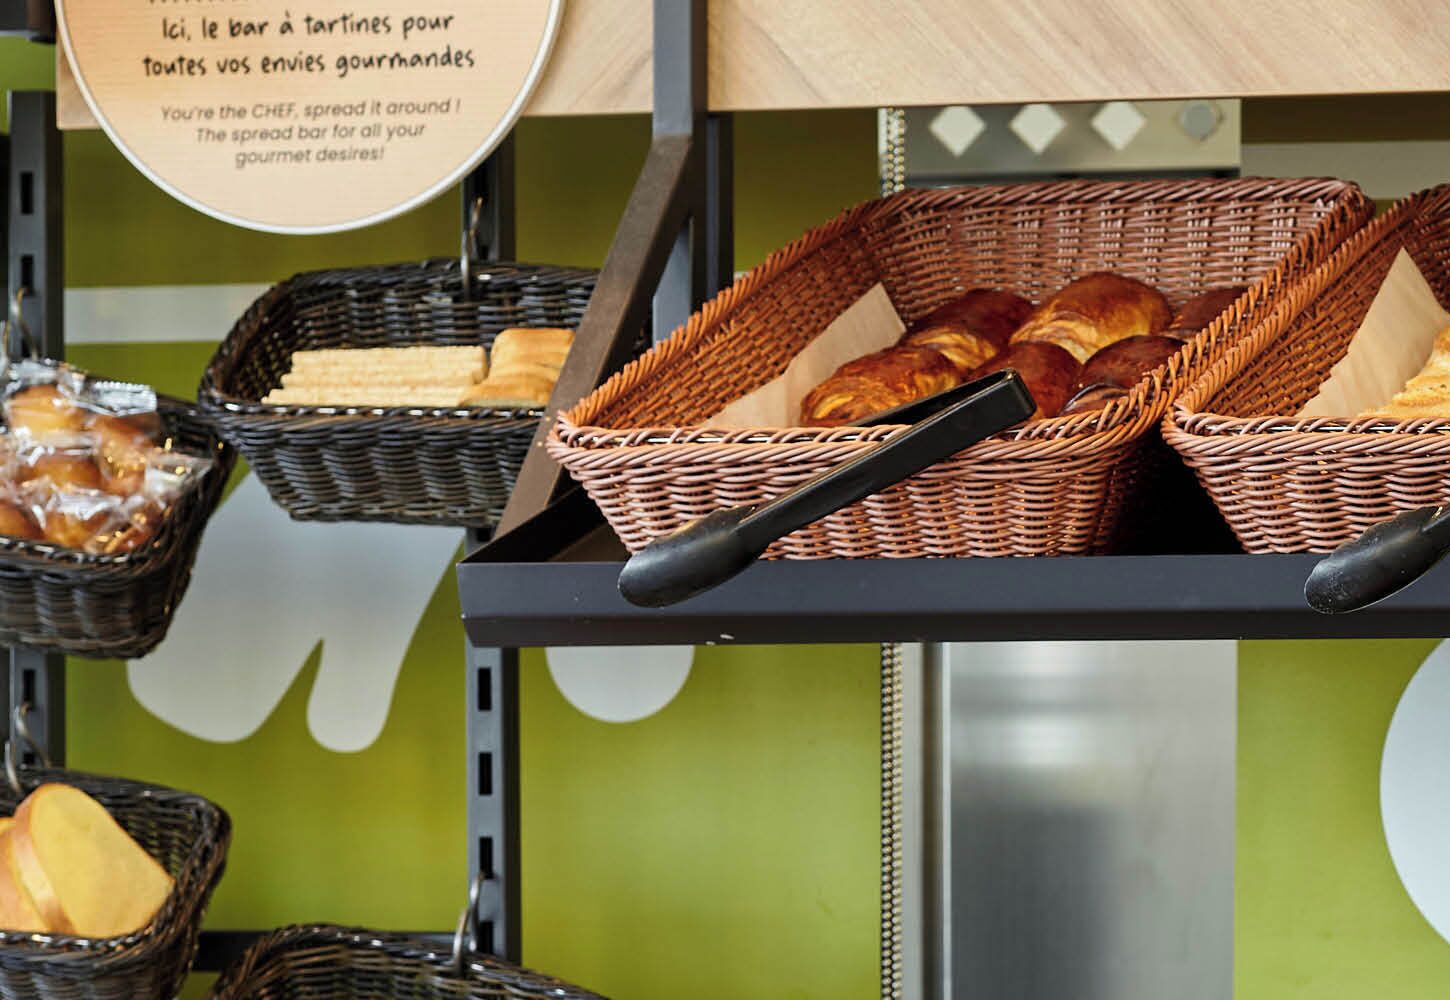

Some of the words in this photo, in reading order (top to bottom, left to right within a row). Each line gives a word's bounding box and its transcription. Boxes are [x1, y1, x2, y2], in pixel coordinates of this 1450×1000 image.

[162, 17, 191, 41] Ici,
[201, 17, 218, 39] le
[228, 17, 269, 38] bar
[279, 10, 294, 35] à
[304, 12, 392, 35] tartines
[402, 14, 454, 40] pour
[142, 54, 207, 77] toutes
[216, 55, 250, 74] vos
[260, 50, 325, 74] envies
[335, 44, 475, 79] gourmandes
[160, 104, 214, 121] You're
[218, 104, 247, 120] the
[251, 102, 299, 119] CHEF,
[303, 101, 366, 121] spread
[370, 100, 382, 117] it
[386, 98, 452, 115] around
[197, 128, 227, 142] The
[231, 126, 295, 147] spread
[297, 124, 328, 141] bar
[332, 123, 356, 139] for
[360, 123, 382, 138] all
[386, 123, 426, 142] your
[234, 147, 312, 170] gourmet
[315, 145, 385, 162] desires!
